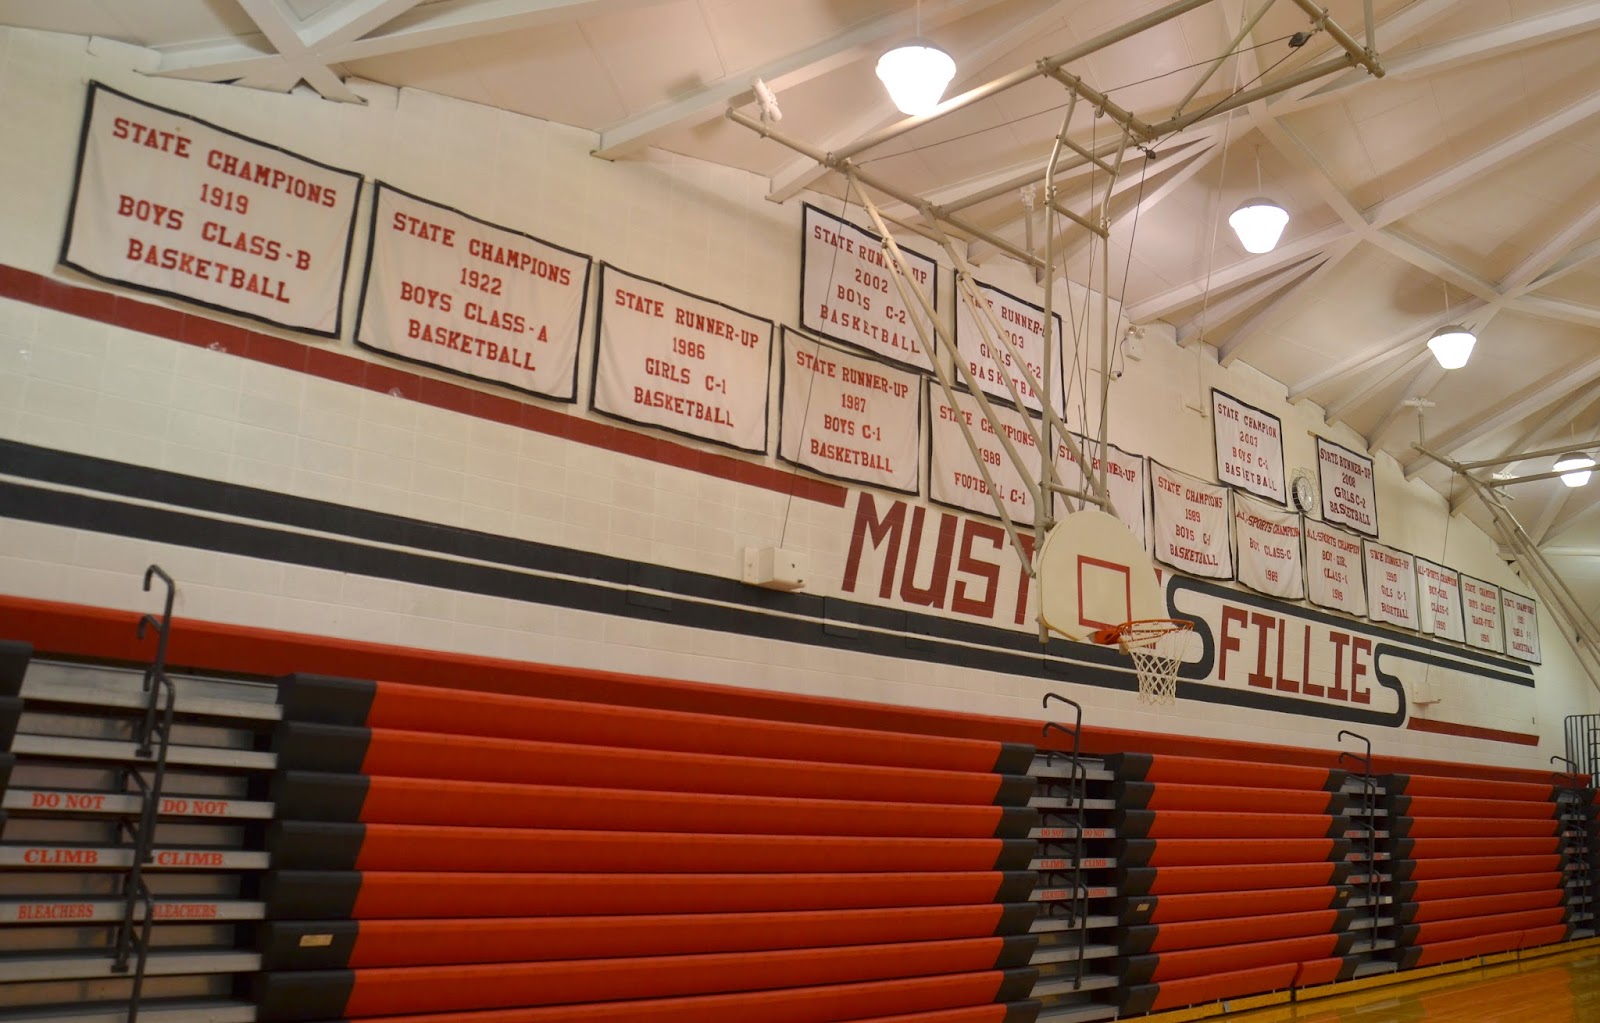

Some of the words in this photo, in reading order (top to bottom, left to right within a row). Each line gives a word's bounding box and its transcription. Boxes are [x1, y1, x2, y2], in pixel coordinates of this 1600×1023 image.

[112, 117, 192, 159] STATE
[207, 150, 336, 208] CHAMPIONS
[200, 183, 249, 215] 1919
[118, 194, 184, 231] BOYS
[202, 221, 311, 271] CLASS-B
[814, 225, 854, 254] STATE
[393, 212, 456, 247] STATE
[469, 239, 571, 286] CHAMPIONS
[127, 238, 290, 304] BASKETBALL
[460, 268, 502, 296] 1922
[855, 268, 888, 294] 2002
[400, 282, 452, 312] BOYS
[464, 302, 547, 343] CLASS-A
[616, 289, 664, 318] STATE
[675, 308, 759, 348] RUNNER-UP
[837, 285, 870, 311] BOYS
[886, 306, 905, 324] C-2
[820, 304, 920, 354] BASKETBALL
[408, 319, 536, 371] BASKETBALL
[673, 337, 705, 360] 1986
[980, 343, 1011, 366] GILS
[645, 358, 690, 384] GIRLS
[705, 375, 726, 394] C-1
[797, 351, 836, 378] STATE
[842, 367, 908, 399] RUNNER-UP
[634, 387, 734, 427] BASKETBALL
[842, 394, 866, 413] 1987
[824, 414, 855, 436] BOYS
[862, 425, 881, 441] C-1
[1218, 404, 1239, 421] STATE
[1244, 416, 1277, 438] CHAMPION
[811, 439, 893, 473] BASKETBALL
[1232, 447, 1251, 463] BOYS
[1320, 448, 1338, 465] STATE
[1339, 456, 1370, 479] RUNNER-UP
[1010, 489, 1025, 505] C-1
[1158, 476, 1181, 496] STATE
[1185, 489, 1222, 508] CHAMPIONS
[1334, 487, 1354, 503] GIRLS
[1185, 509, 1200, 522] 1989
[1176, 524, 1194, 541] BOYS
[1170, 544, 1218, 566] BASKETBALL
[1264, 546, 1291, 560] CLASS-C
[1218, 604, 1406, 728] FILLIES
[32, 793, 60, 808] DO
[65, 794, 105, 810] NOT
[163, 799, 188, 814] DO
[192, 801, 228, 815] NOT
[1051, 829, 1064, 837] NOT
[24, 849, 98, 865] CLIMB
[157, 852, 224, 866] CLIMB
[18, 904, 93, 919] BLEACHERS
